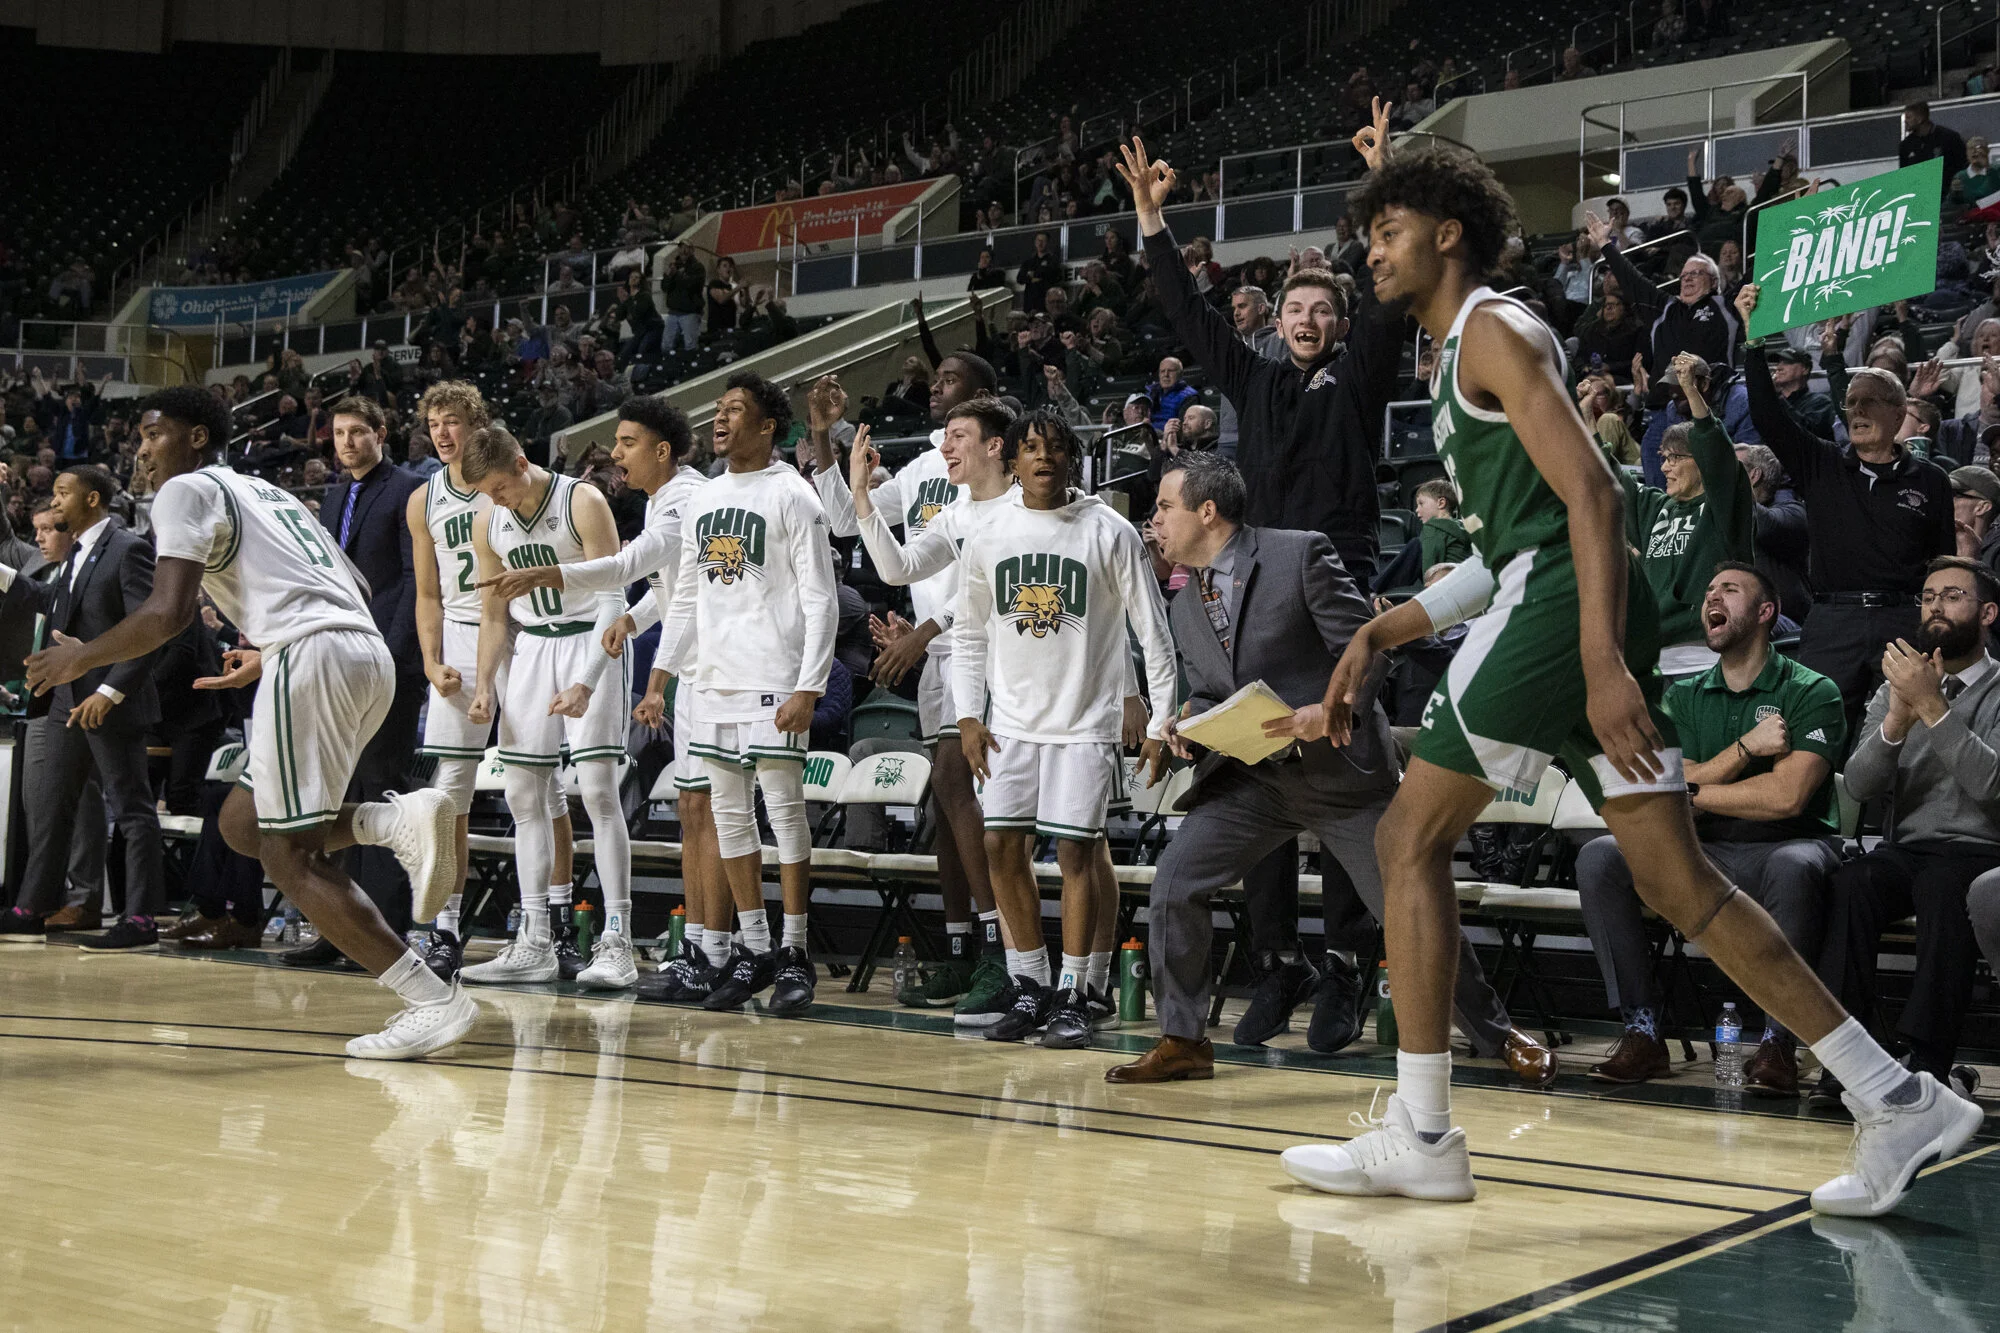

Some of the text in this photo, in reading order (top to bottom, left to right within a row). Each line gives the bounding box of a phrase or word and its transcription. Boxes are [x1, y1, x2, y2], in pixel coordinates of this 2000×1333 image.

[1781, 205, 1908, 293] BANG!
[273, 508, 334, 568] 15
[444, 511, 478, 549] OH
[695, 508, 767, 567] OHIO
[457, 551, 475, 592] 2
[995, 553, 1088, 618] OHIO
[529, 586, 563, 617] 10
[802, 757, 835, 788] HIO
